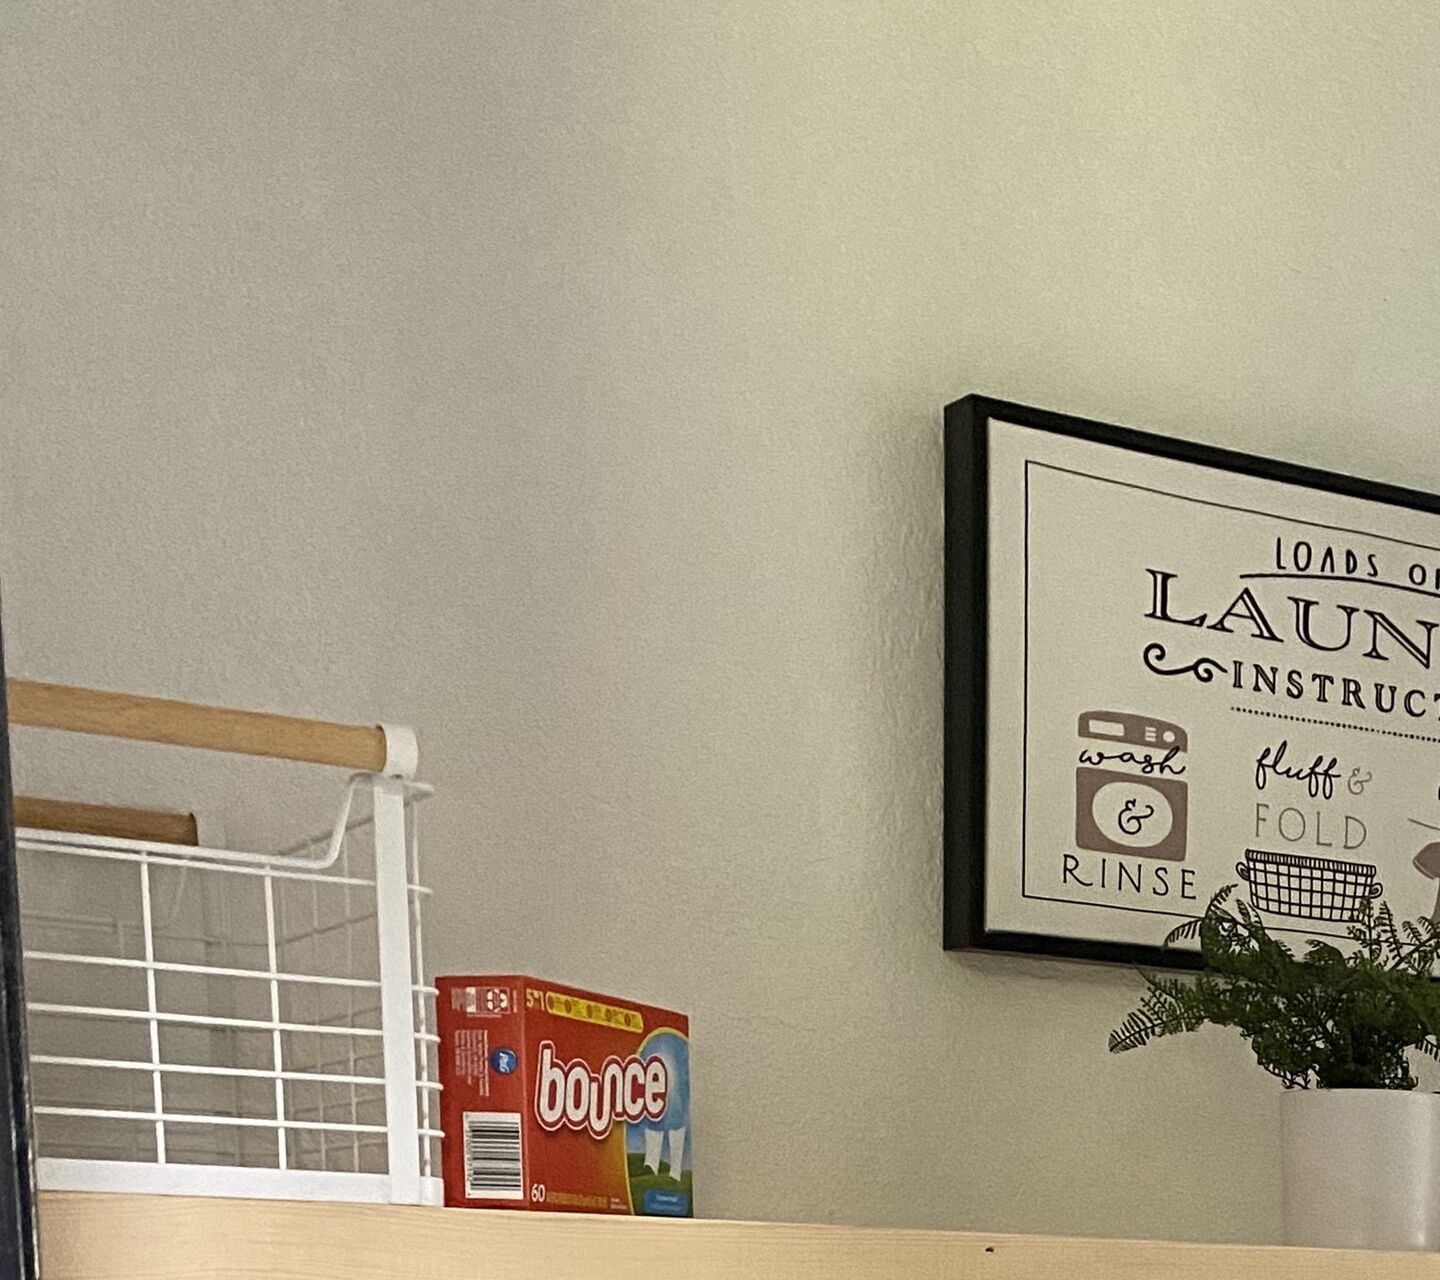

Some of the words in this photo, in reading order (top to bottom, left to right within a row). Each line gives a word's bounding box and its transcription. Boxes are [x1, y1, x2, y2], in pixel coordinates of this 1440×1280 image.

[1276, 536, 1378, 577] LOADS
[1079, 744, 1187, 776] wash
[1255, 740, 1341, 800] fluff
[1347, 765, 1373, 796] &
[1117, 798, 1155, 836] &
[1254, 802, 1368, 851] FOLD
[1062, 853, 1197, 901] RINSE
[537, 1043, 668, 1137] bounce
[531, 1184, 546, 1203] 60
